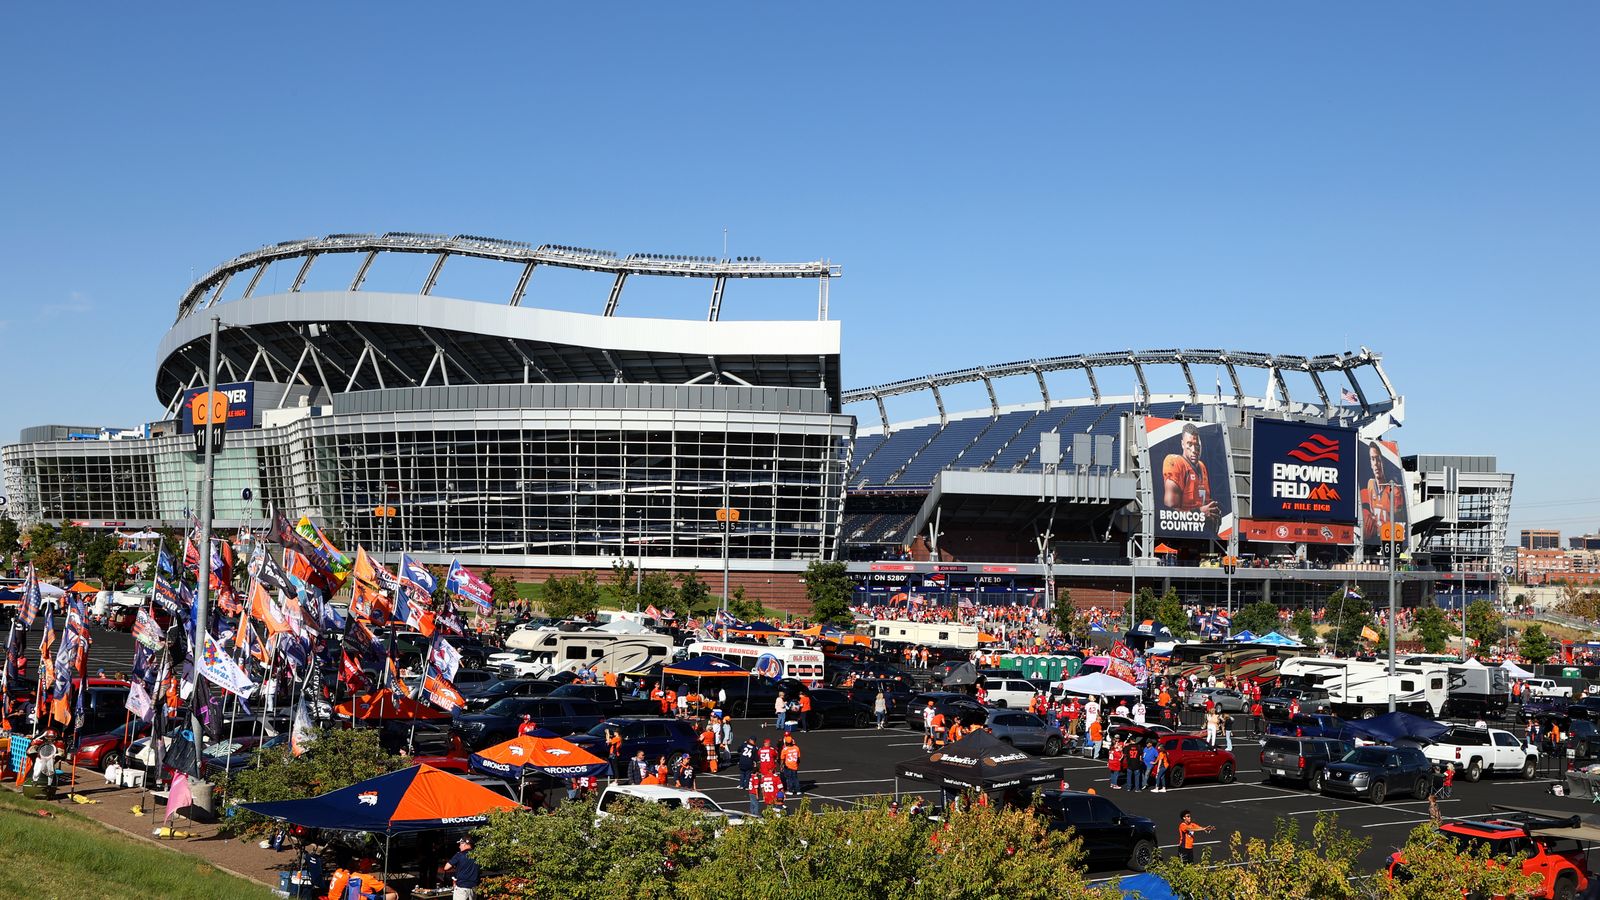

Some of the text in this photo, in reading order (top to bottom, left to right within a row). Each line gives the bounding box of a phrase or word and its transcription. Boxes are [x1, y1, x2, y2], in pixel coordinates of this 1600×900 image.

[198, 404, 206, 420] C
[215, 402, 222, 418] C
[197, 430, 204, 446] 11
[214, 428, 220, 445] 11
[1273, 463, 1338, 484] EMPOWER
[1273, 481, 1310, 499] FIELD
[1160, 510, 1206, 522] BRONCOS
[1160, 521, 1206, 532] COUNTRY
[1385, 529, 1390, 538] C
[1396, 530, 1400, 539] C
[1385, 544, 1389, 553] 6
[1396, 544, 1400, 553] 6
[729, 647, 758, 655] BRONCOS
[430, 692, 454, 711] ORANGE
[743, 747, 752, 758] 24
[760, 753, 770, 762] 54
[990, 752, 1028, 762] TimberTech
[941, 754, 978, 765] TimberTech
[482, 760, 510, 772] BRONCOS
[544, 766, 587, 774] BRONCOS
